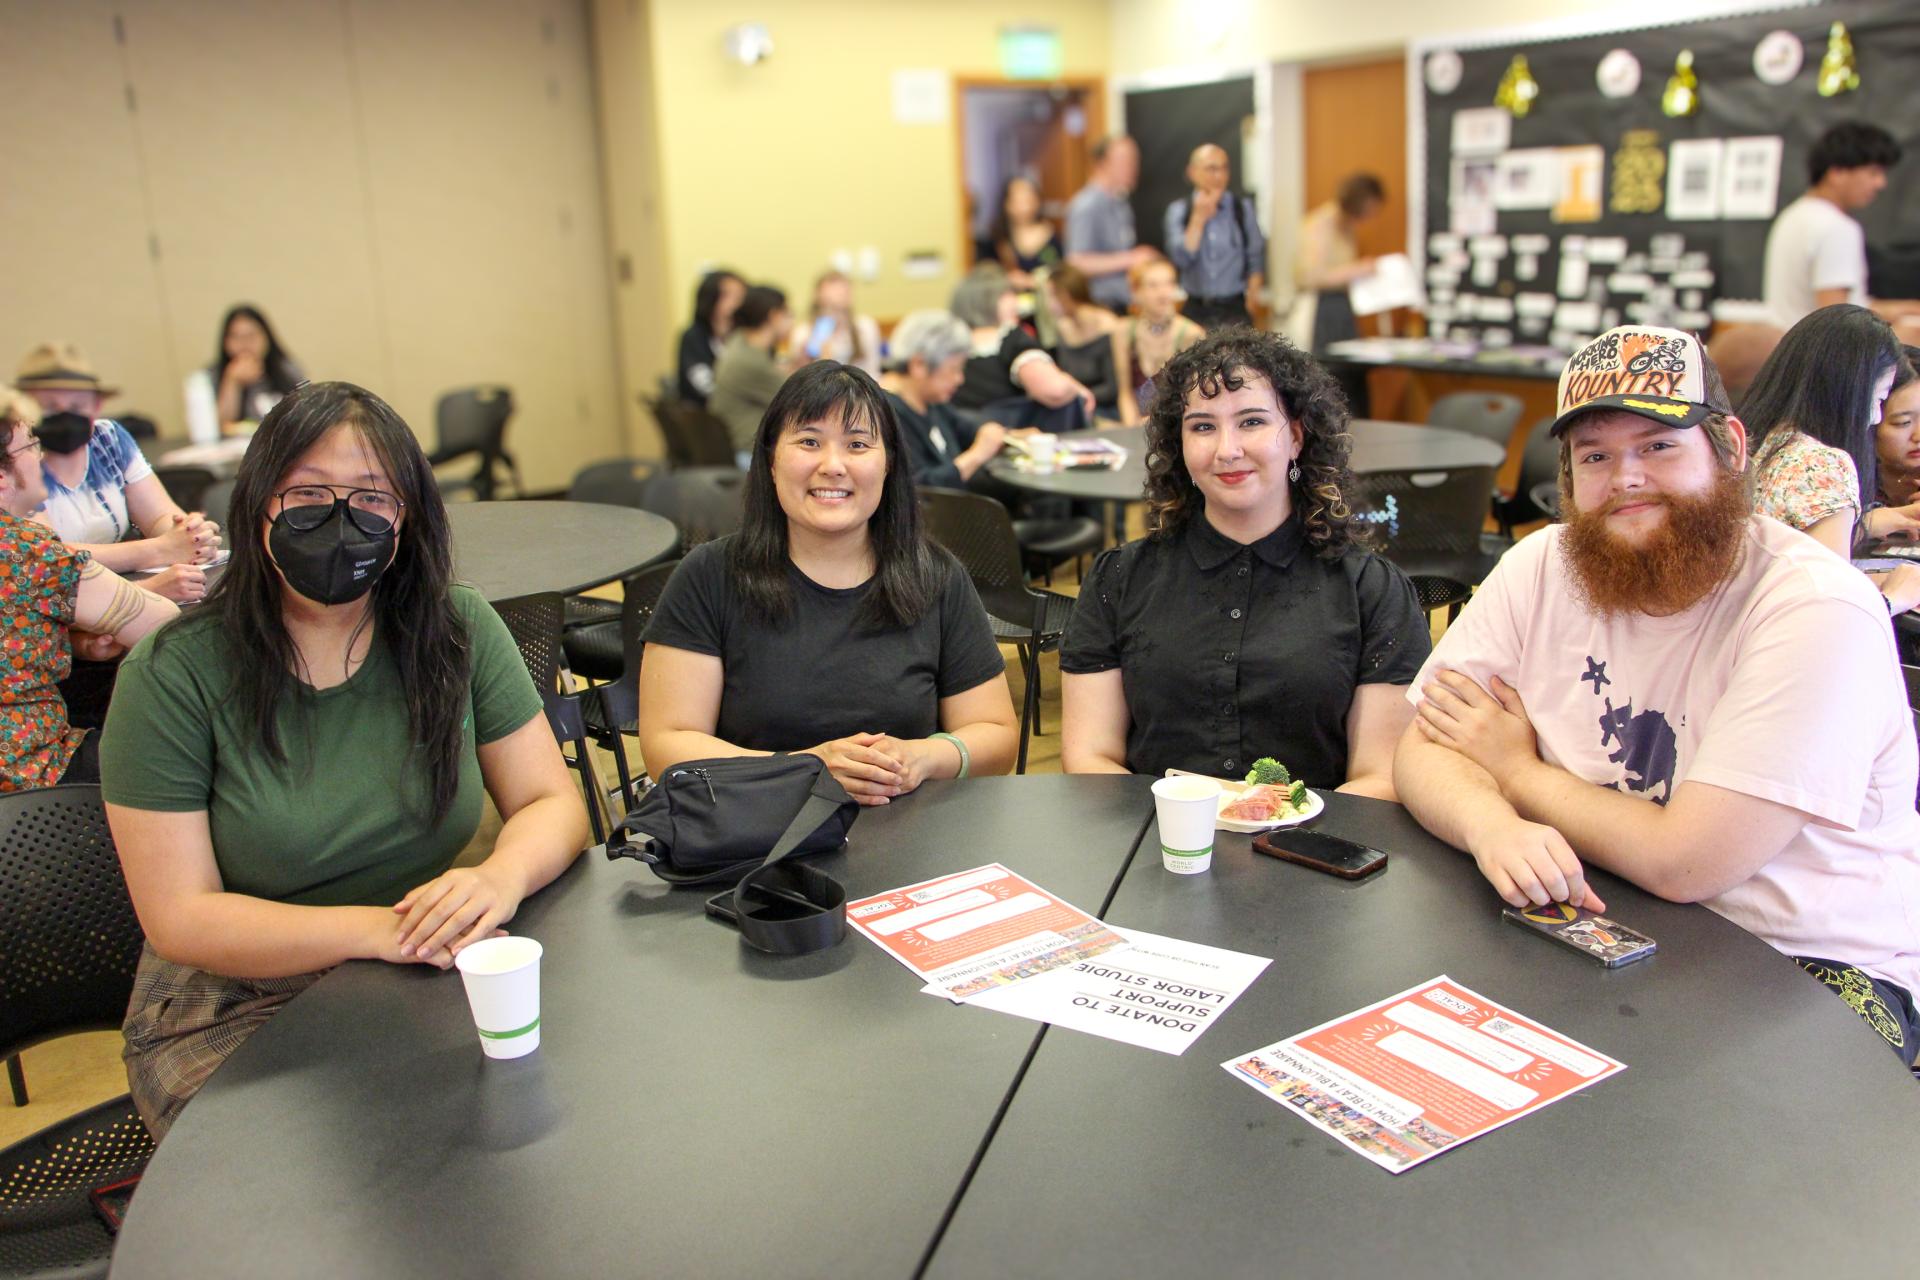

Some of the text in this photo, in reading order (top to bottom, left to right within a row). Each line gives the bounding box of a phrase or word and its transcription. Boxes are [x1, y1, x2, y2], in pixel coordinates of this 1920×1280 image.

[1568, 333, 1620, 373] WORKING
[1579, 346, 1617, 372] HERO
[1594, 360, 1617, 373] PLAY
[1562, 371, 1685, 408] KOUNTRY
[1107, 987, 1212, 1018] SUPPORT
[1150, 980, 1227, 1003] LABOR
[1068, 995, 1198, 1032] DONATE TO
[1267, 1048, 1332, 1084] BILLIONNAIRE
[1333, 1087, 1365, 1104] BEAT
[1358, 1101, 1378, 1112] TO
[1371, 1109, 1402, 1125] HOW
